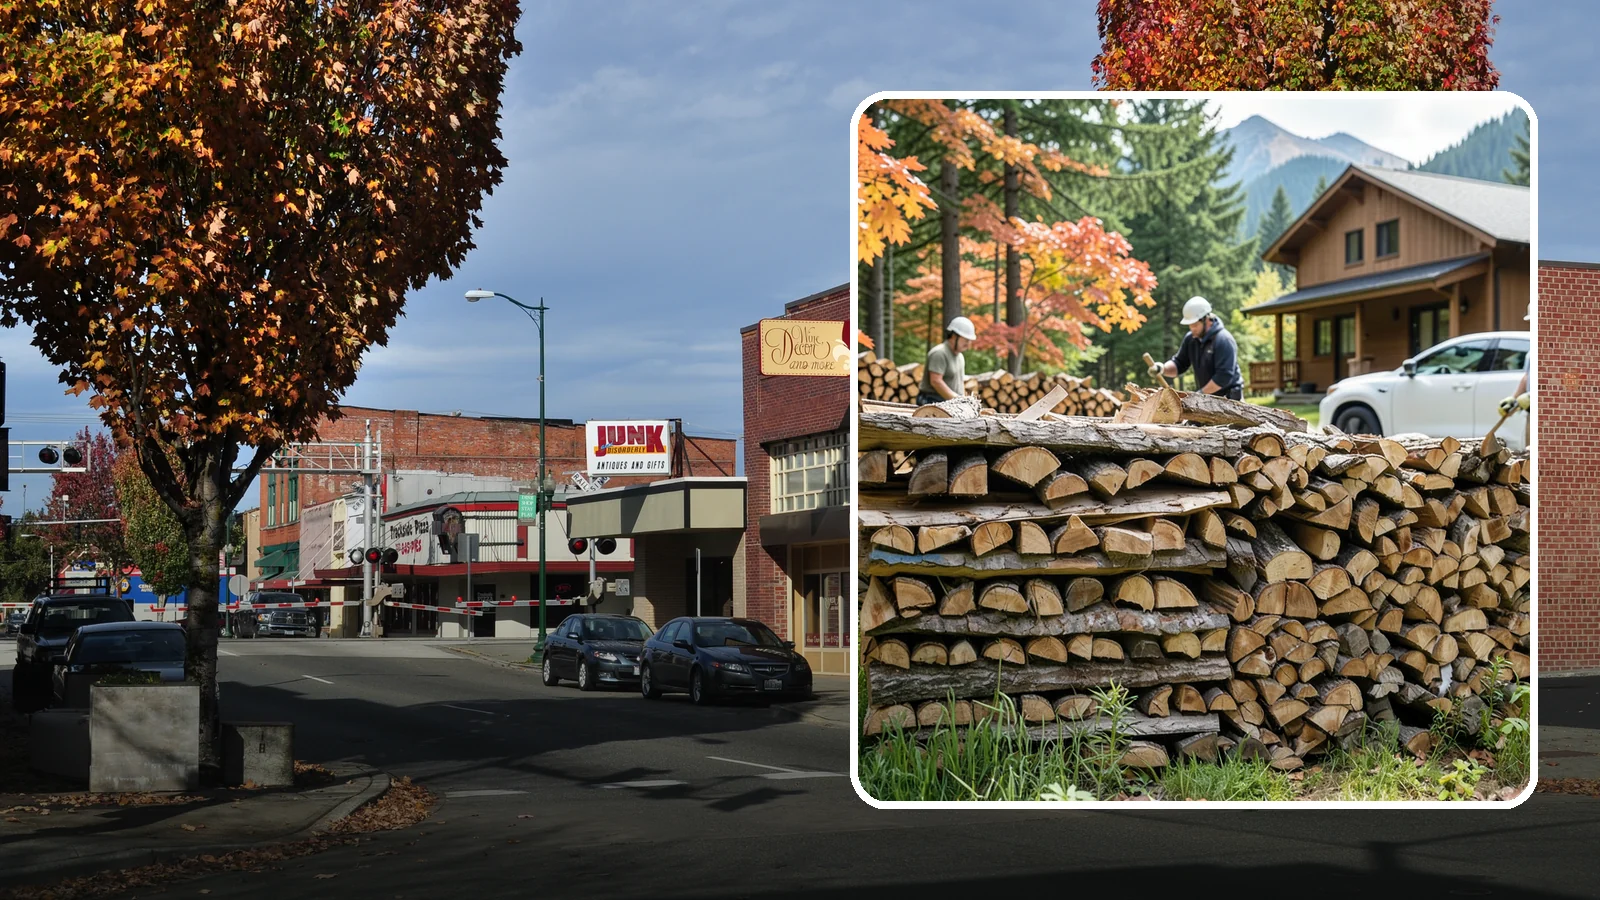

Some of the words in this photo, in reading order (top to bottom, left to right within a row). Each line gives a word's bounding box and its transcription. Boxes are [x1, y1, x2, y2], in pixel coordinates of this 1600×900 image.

[595, 425, 665, 457] JUNK
[607, 446, 646, 454] DISORDERLY
[596, 460, 628, 471] ANTIQUES
[631, 460, 644, 470] AND
[646, 460, 665, 470] GIFTS
[414, 519, 429, 535] Pizza
